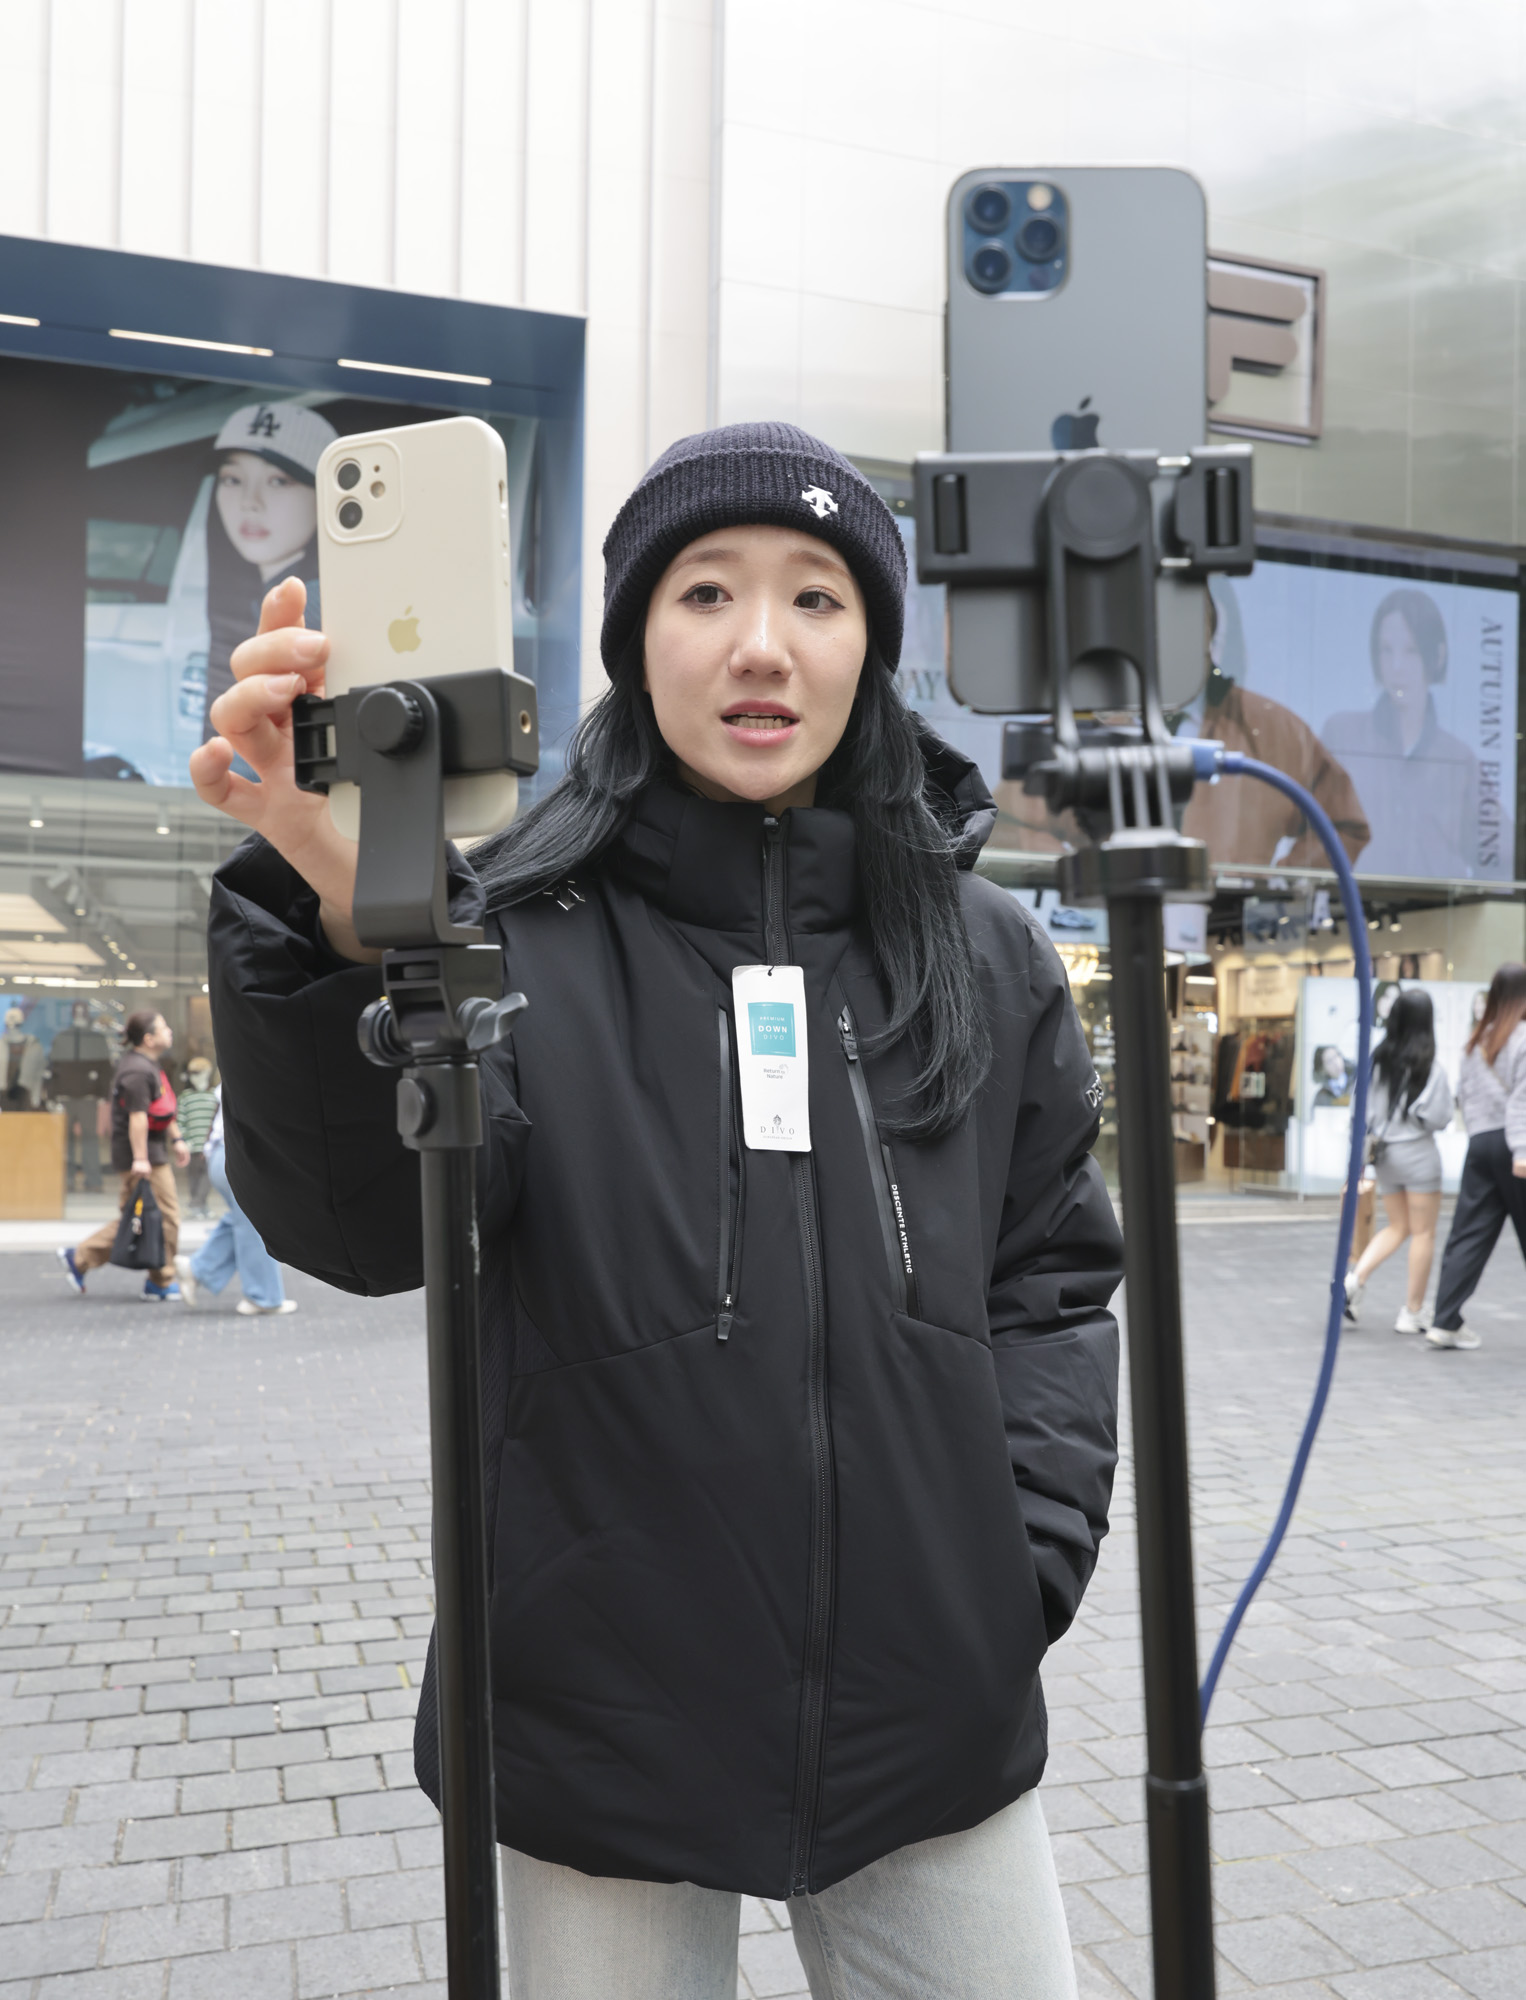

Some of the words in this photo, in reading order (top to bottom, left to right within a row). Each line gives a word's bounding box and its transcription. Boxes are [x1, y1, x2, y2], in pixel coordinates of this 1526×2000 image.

[1480, 616, 1504, 749] AUTUMN
[1477, 760, 1502, 869] BEGINS
[758, 1025, 788, 1033] DOWN
[760, 1125, 795, 1135] DIVO
[891, 1184, 905, 1228] DESCENTE
[900, 1230, 913, 1274] ATHLETIC
